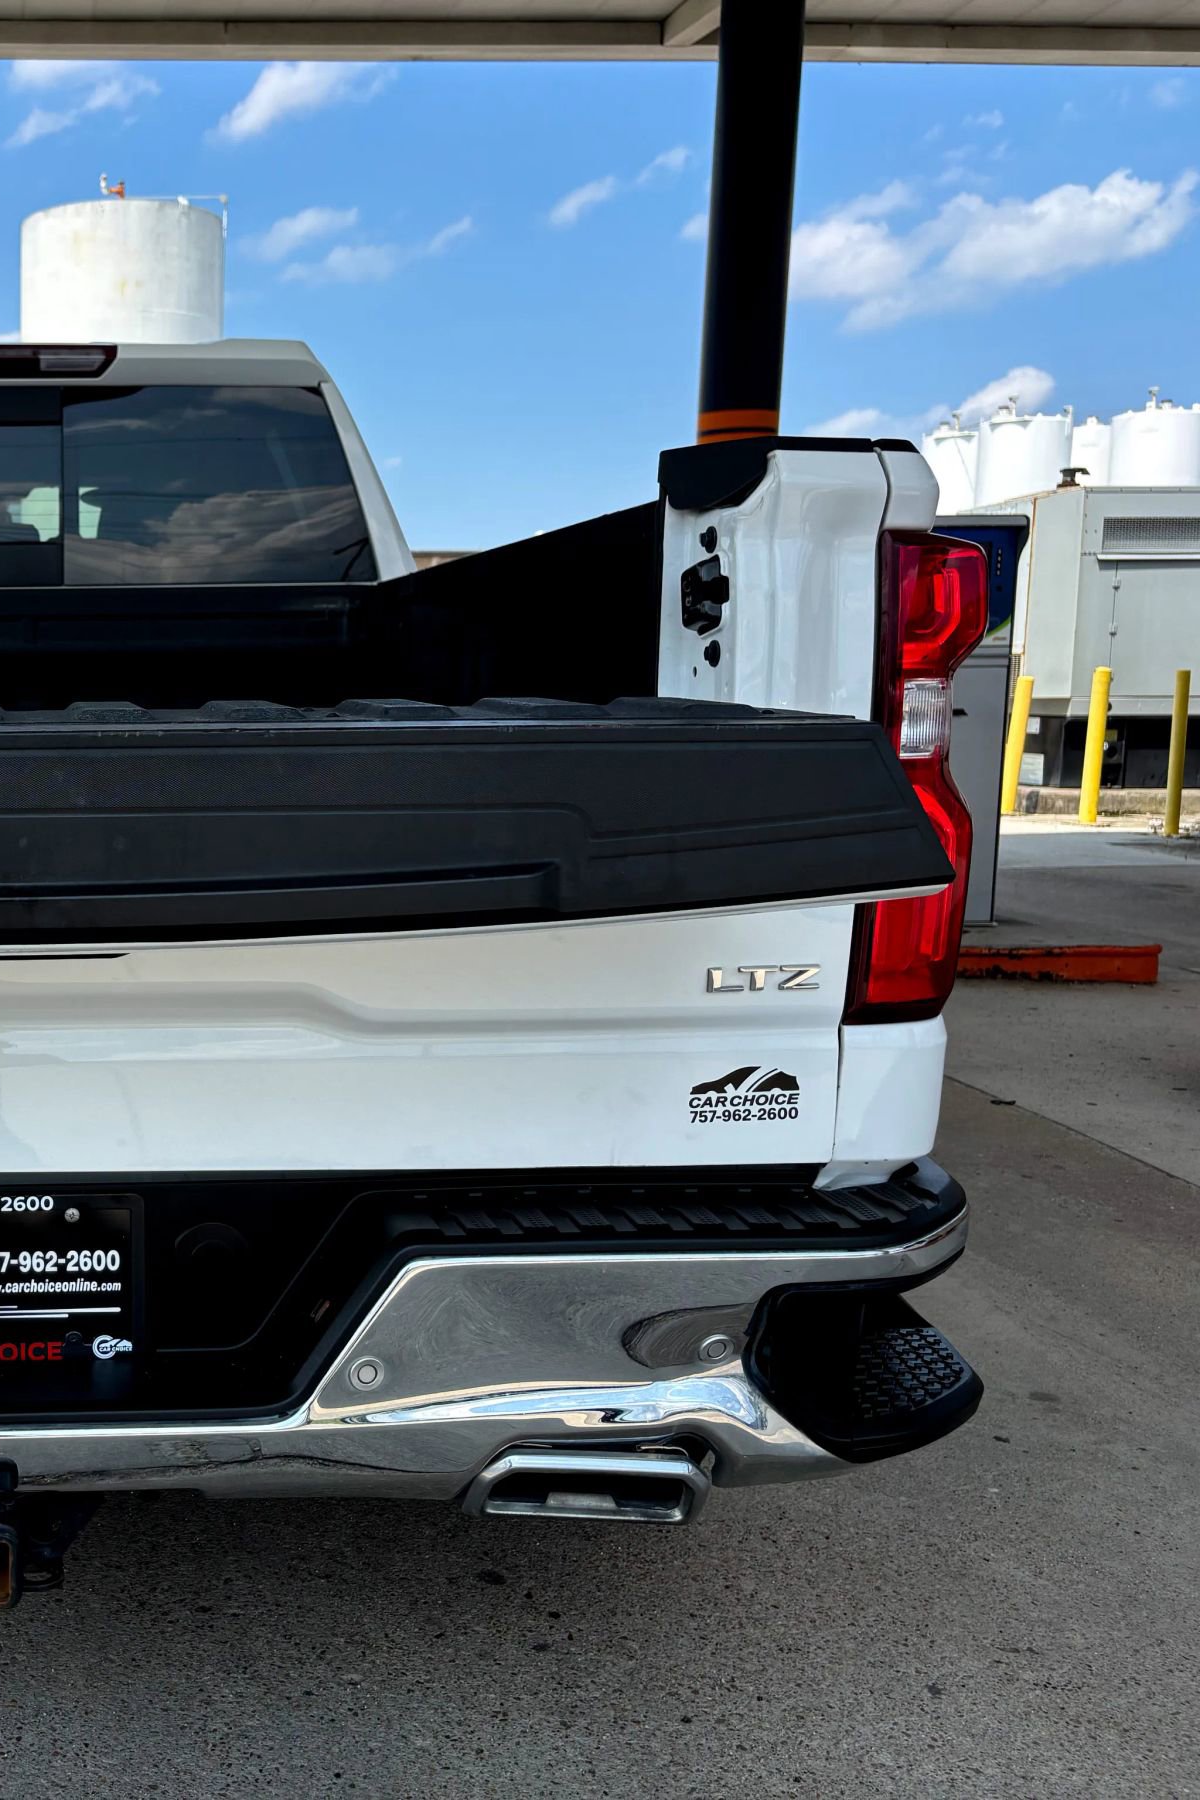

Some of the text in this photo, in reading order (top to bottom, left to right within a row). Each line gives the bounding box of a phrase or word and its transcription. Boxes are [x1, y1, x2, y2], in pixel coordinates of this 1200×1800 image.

[707, 964, 820, 993] LTZ
[688, 1093, 799, 1109] CAR CHOICE
[690, 1107, 799, 1123] 757-962-2600
